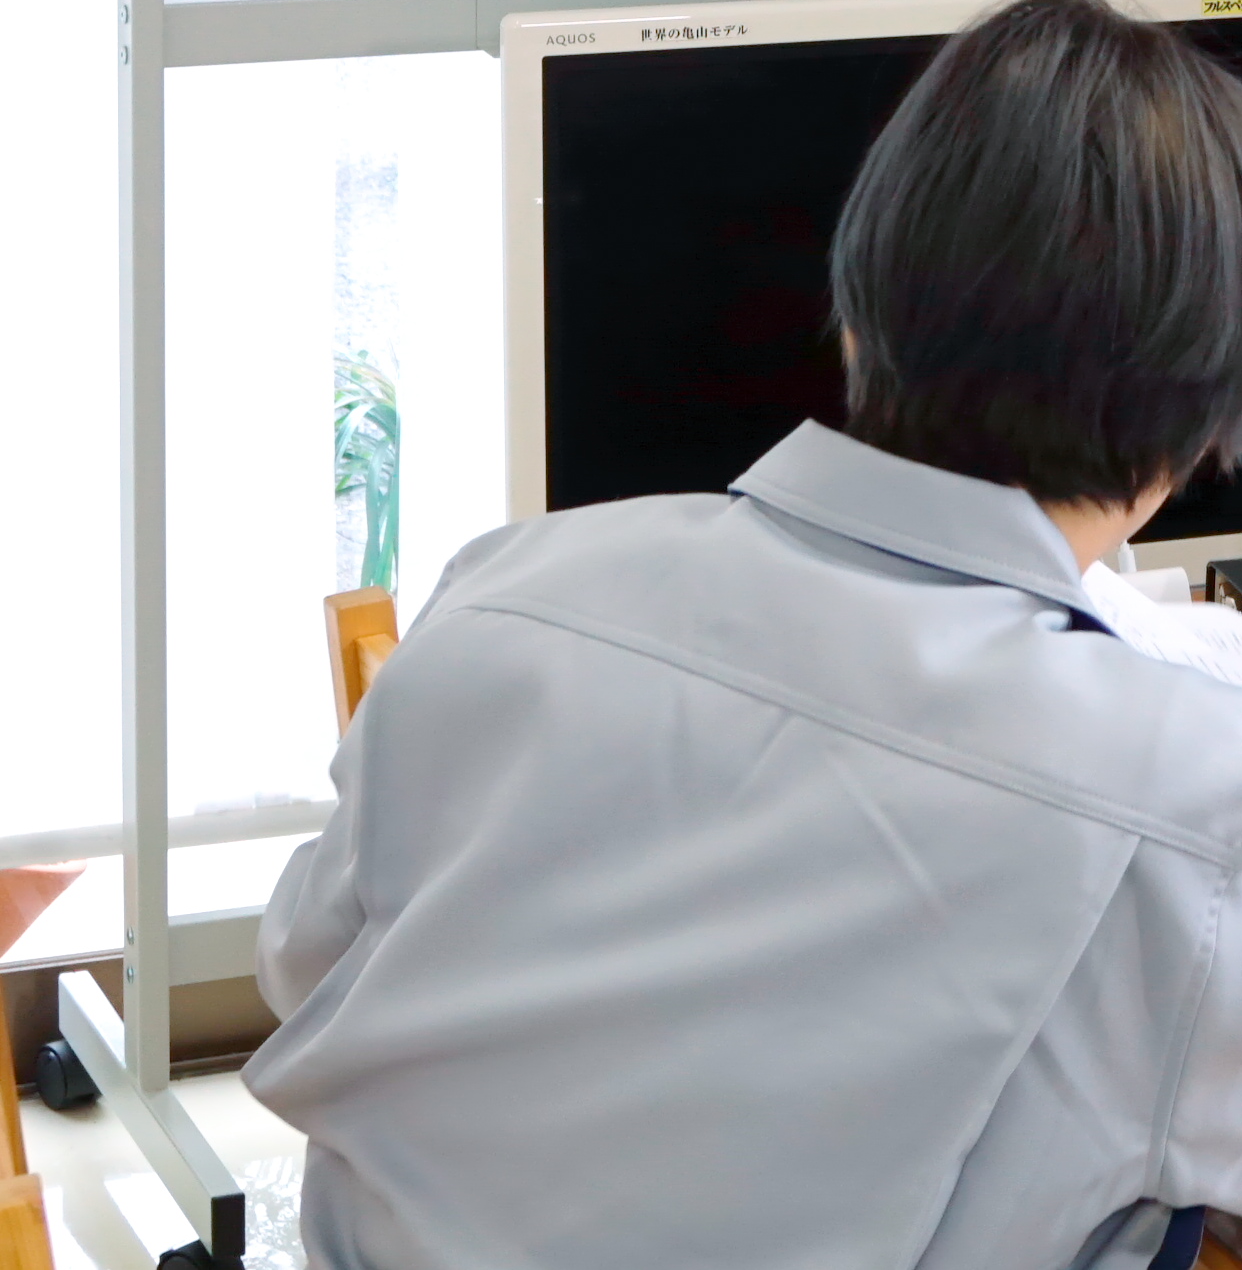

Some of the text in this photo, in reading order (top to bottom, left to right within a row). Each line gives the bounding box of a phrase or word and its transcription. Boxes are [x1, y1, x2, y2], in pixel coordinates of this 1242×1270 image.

[546, 32, 596, 46] AQUOS
[641, 24, 748, 42] 世界の亀山モデル
